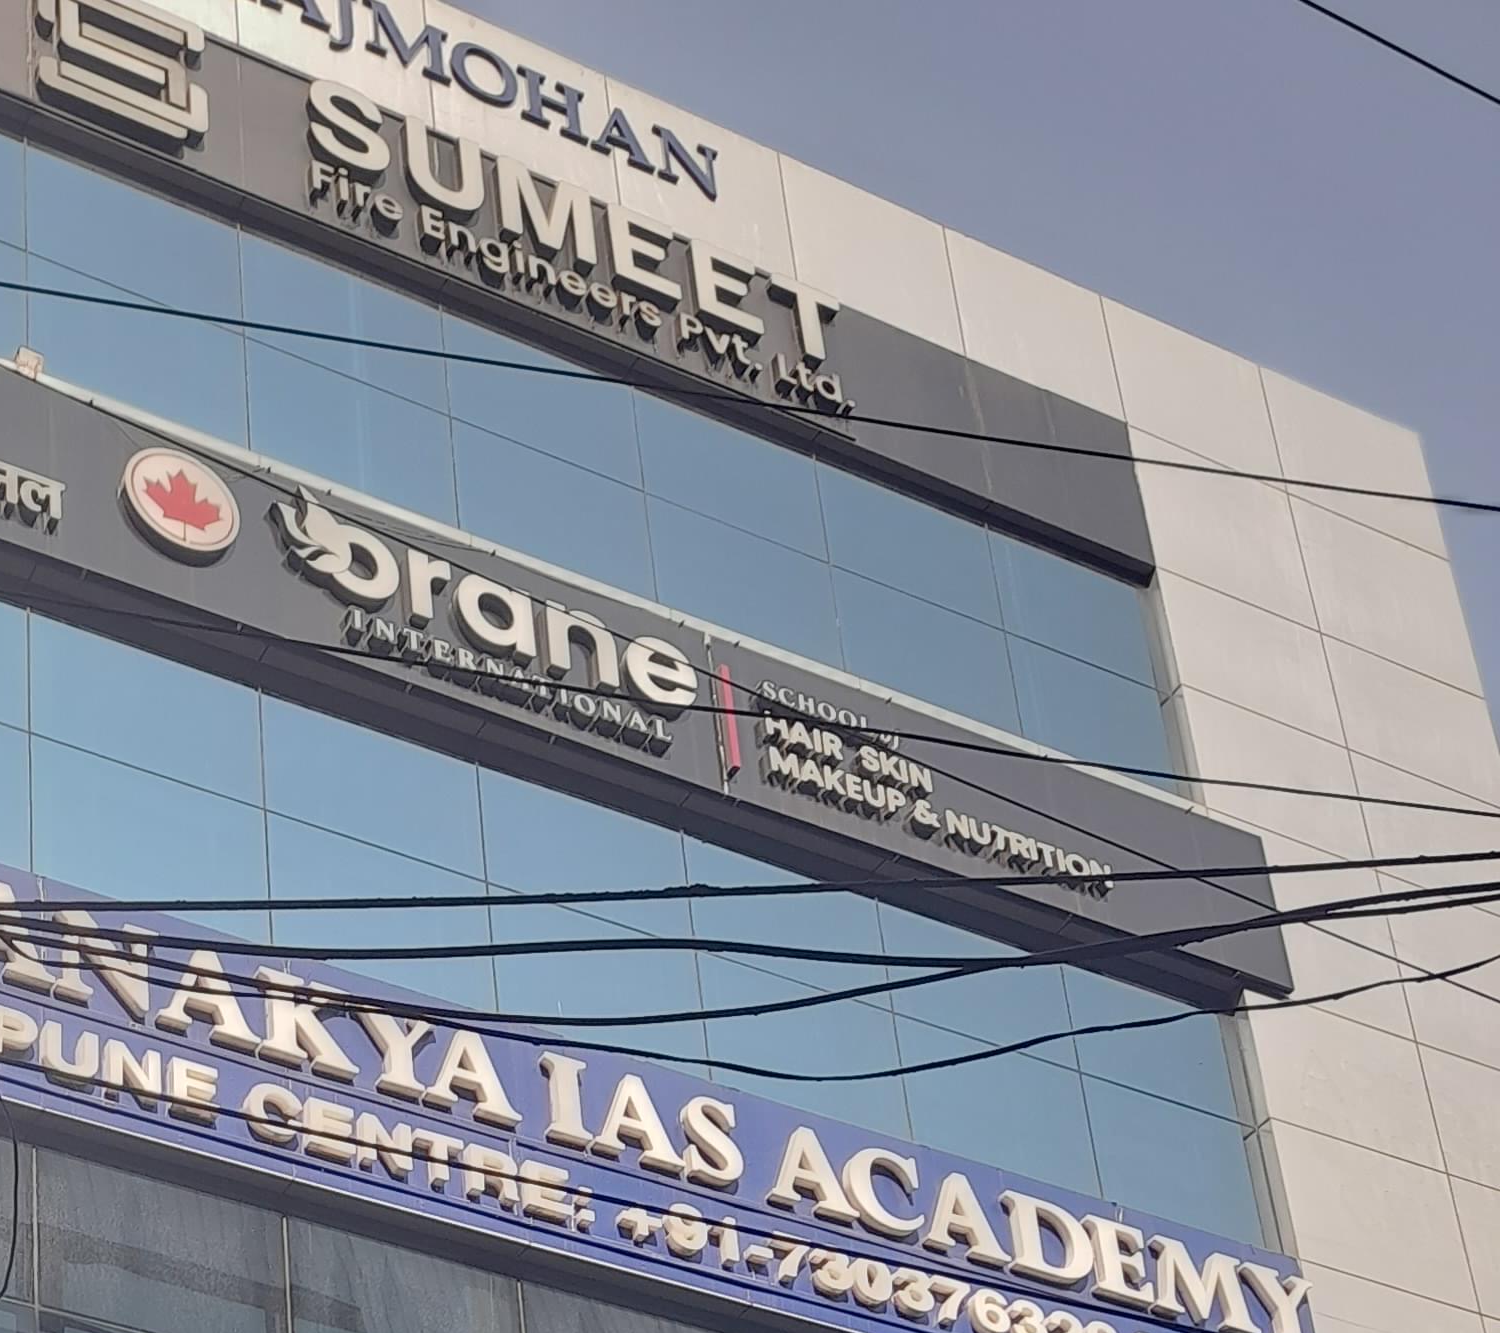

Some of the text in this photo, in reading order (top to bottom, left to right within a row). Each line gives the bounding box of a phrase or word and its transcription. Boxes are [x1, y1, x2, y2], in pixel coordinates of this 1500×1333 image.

[261, 0, 720, 199] JMOHAN
[307, 78, 841, 367] SUMEET
[310, 160, 856, 409] Fire Engineers Pvt. Ltd.
[348, 608, 672, 743] INTERNATIONAL
[762, 710, 934, 793] HAIR SKIN
[768, 746, 1115, 889] MAKEUP & NUTRITION
[239, 1082, 596, 1232] CENTRE:
[538, 1050, 745, 1190] IAS
